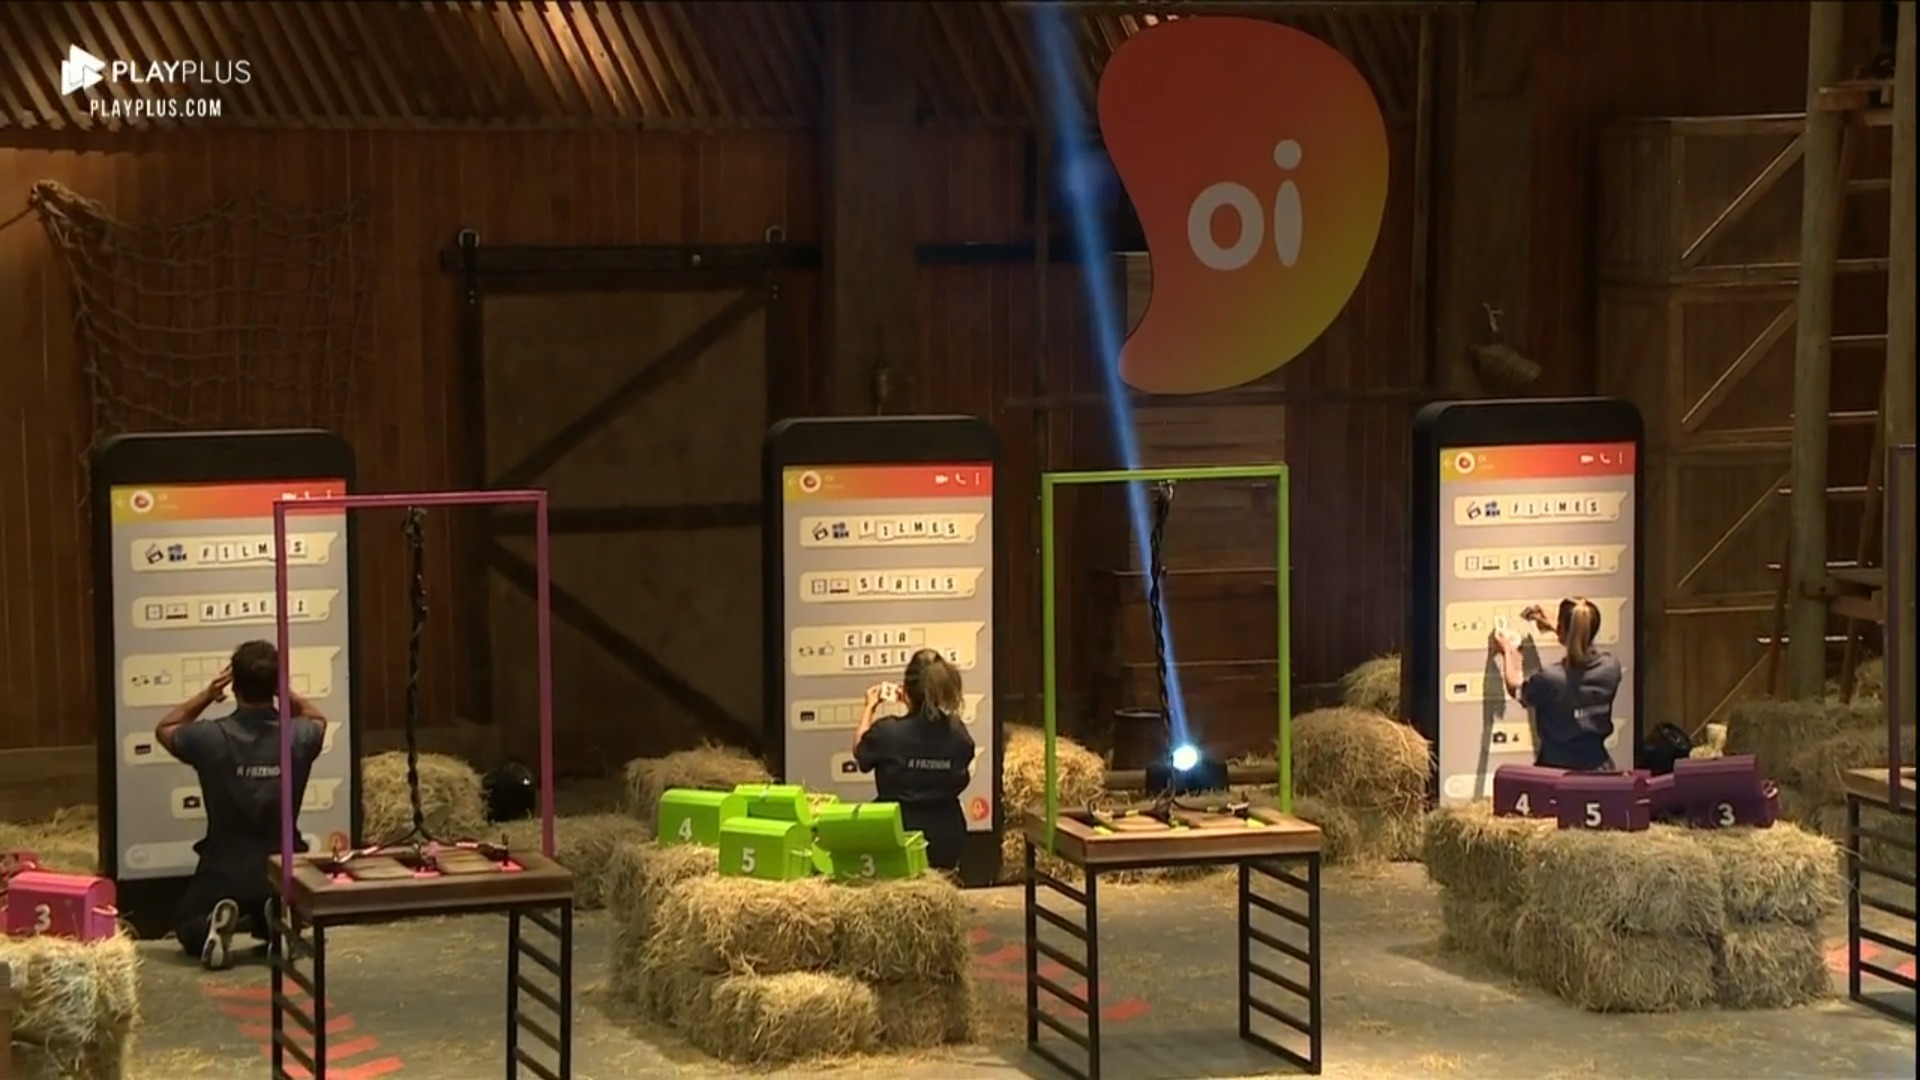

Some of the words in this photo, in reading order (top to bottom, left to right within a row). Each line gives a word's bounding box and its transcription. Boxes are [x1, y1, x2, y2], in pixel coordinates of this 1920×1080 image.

[1513, 501, 1598, 515] FILMES
[863, 521, 956, 537] FILMES
[202, 541, 302, 559] FILMS
[1515, 793, 1531, 816] 4
[1585, 803, 1602, 828] 5
[1717, 803, 1736, 826] 3
[678, 817, 693, 842] 4
[741, 848, 756, 872] 5
[860, 854, 876, 877] 3
[34, 903, 52, 932] 3
